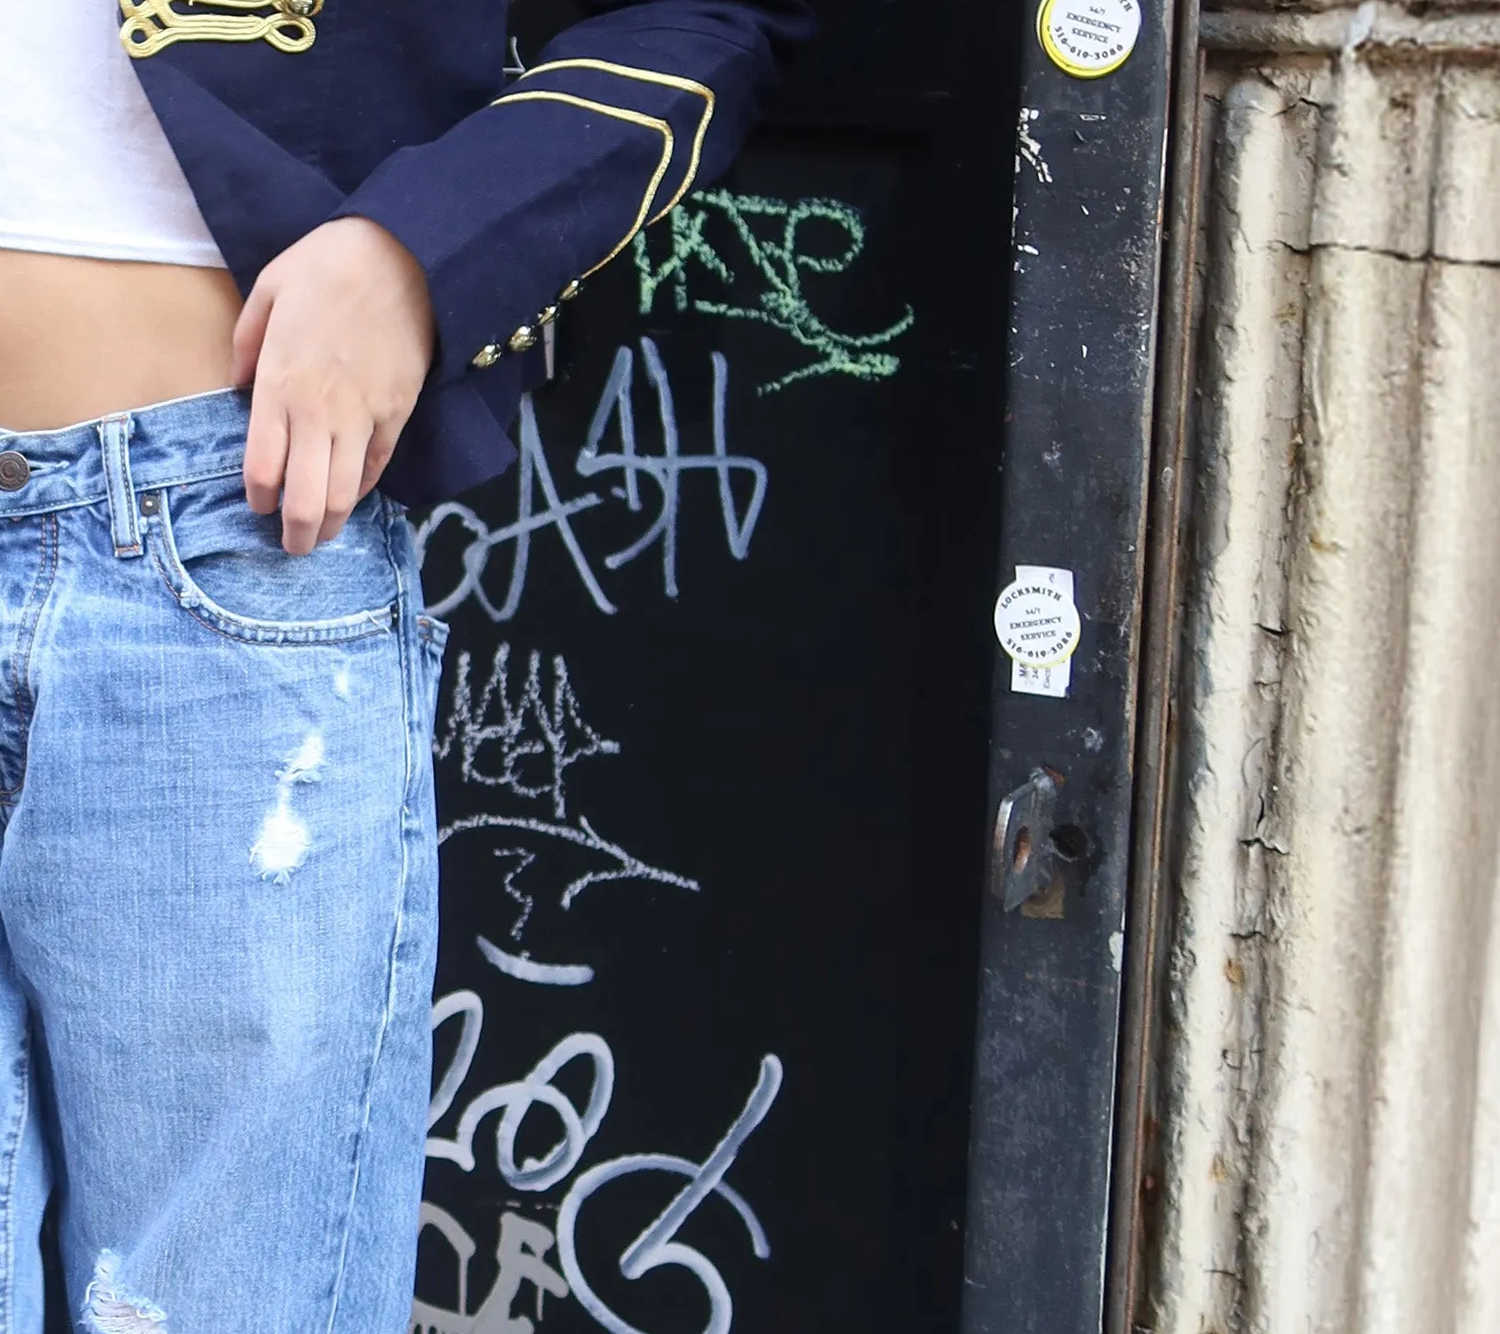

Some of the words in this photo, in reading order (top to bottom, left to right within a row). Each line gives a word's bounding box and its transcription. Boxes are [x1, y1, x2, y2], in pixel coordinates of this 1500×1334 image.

[1066, 13, 1121, 33] EMERGENCY
[1072, 28, 1108, 43] SERVICE
[1002, 586, 1062, 609] LOCKSMITH
[1010, 617, 1062, 629] EMERGENCY
[1021, 630, 1056, 641] SERVICE
